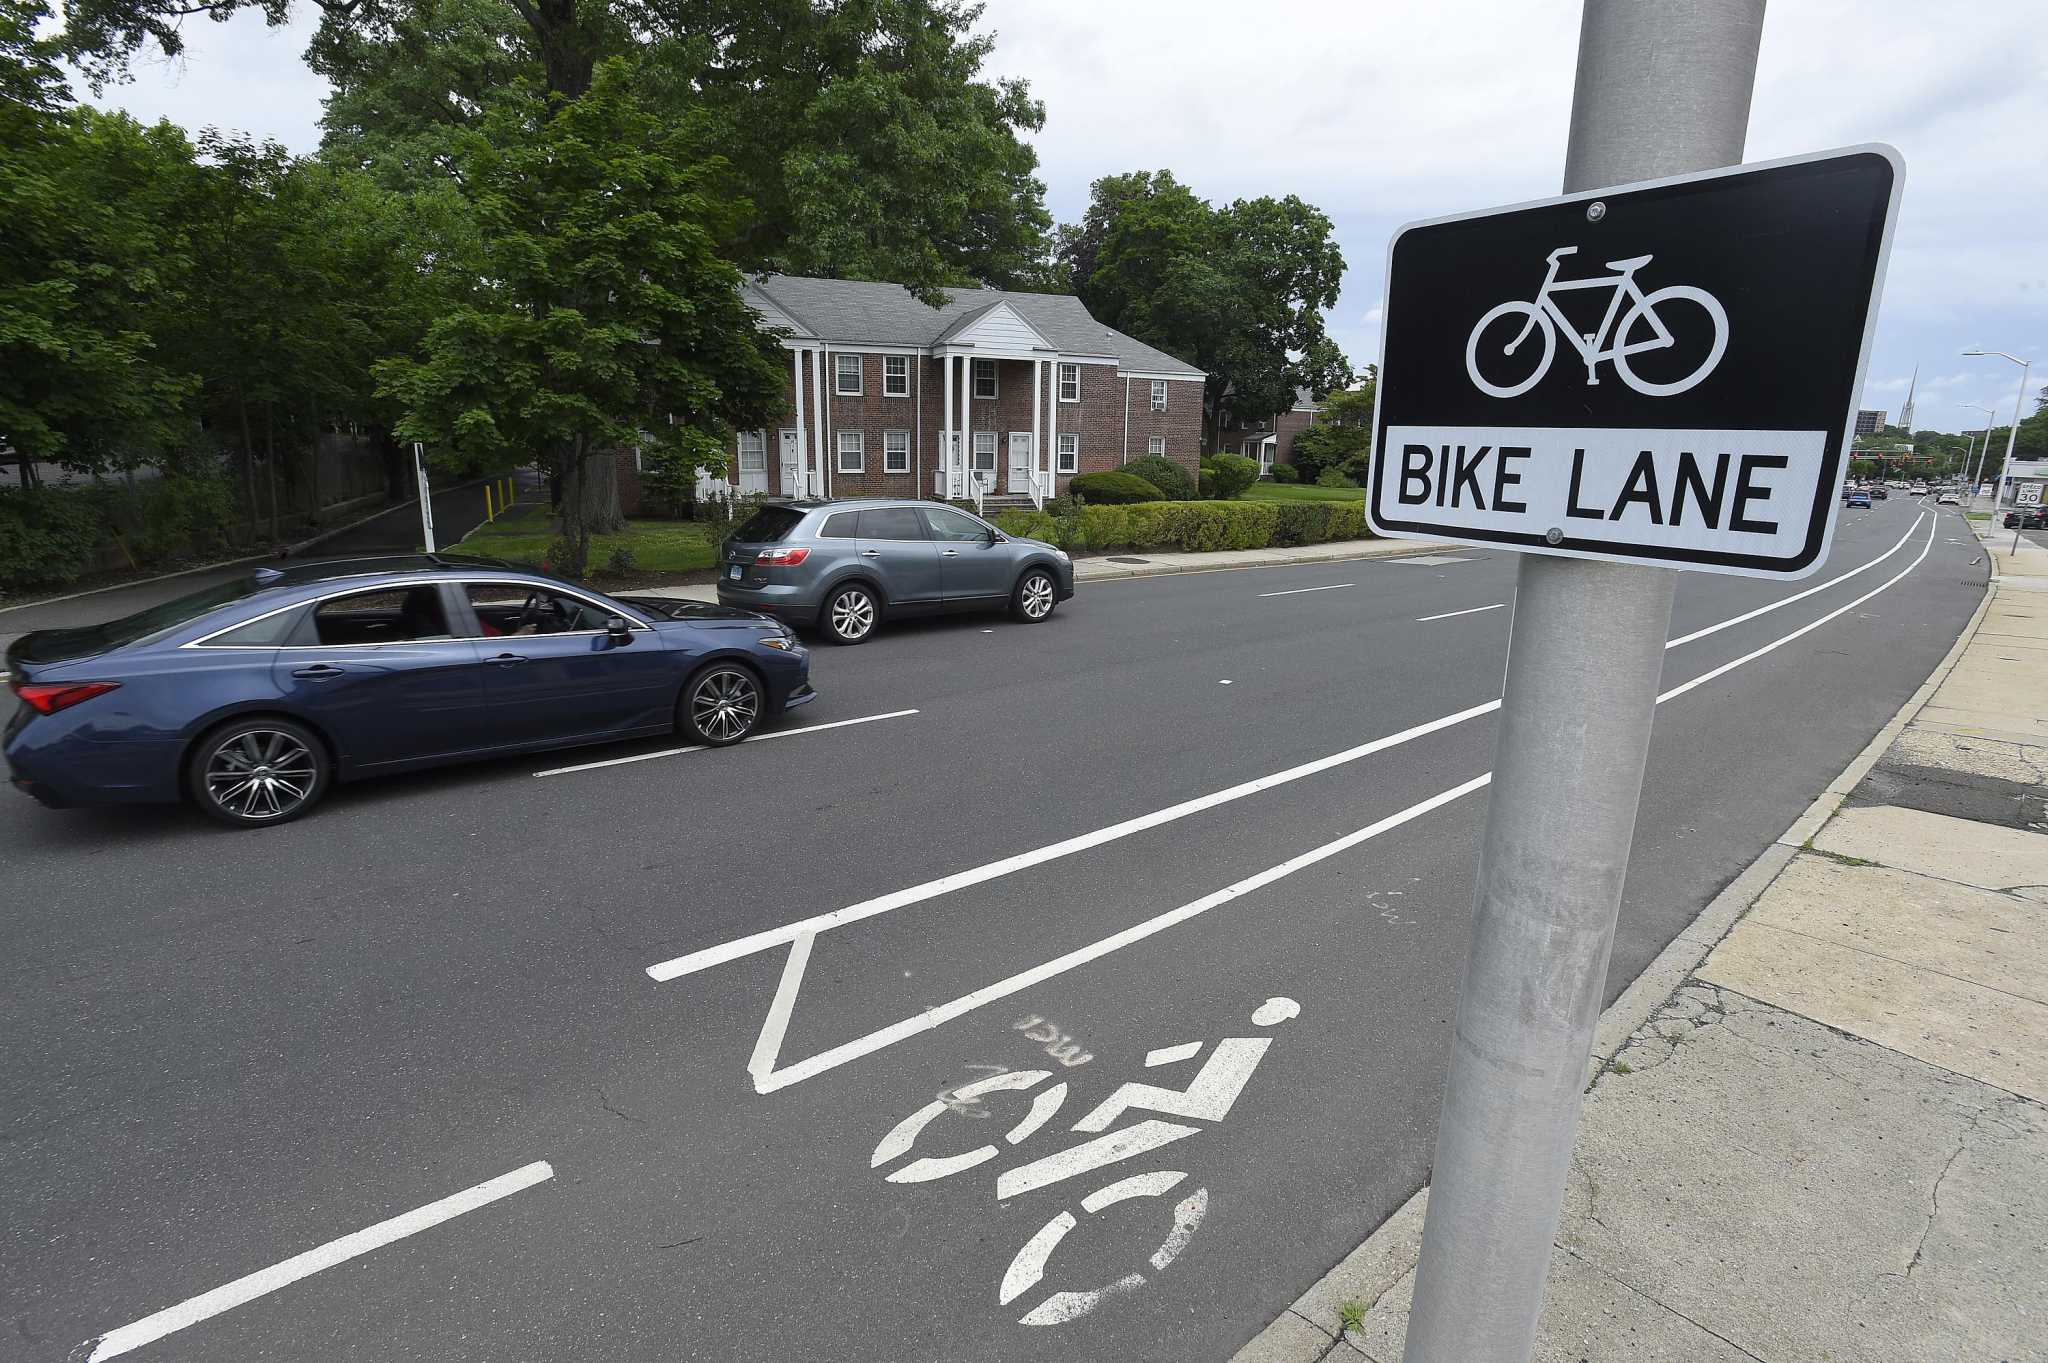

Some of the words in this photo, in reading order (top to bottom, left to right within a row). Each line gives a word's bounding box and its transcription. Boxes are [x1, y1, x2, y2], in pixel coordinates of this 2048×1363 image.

[1398, 444, 1532, 514] BIKE
[1566, 449, 1789, 535] LANE
[2019, 493, 2038, 502] 30
